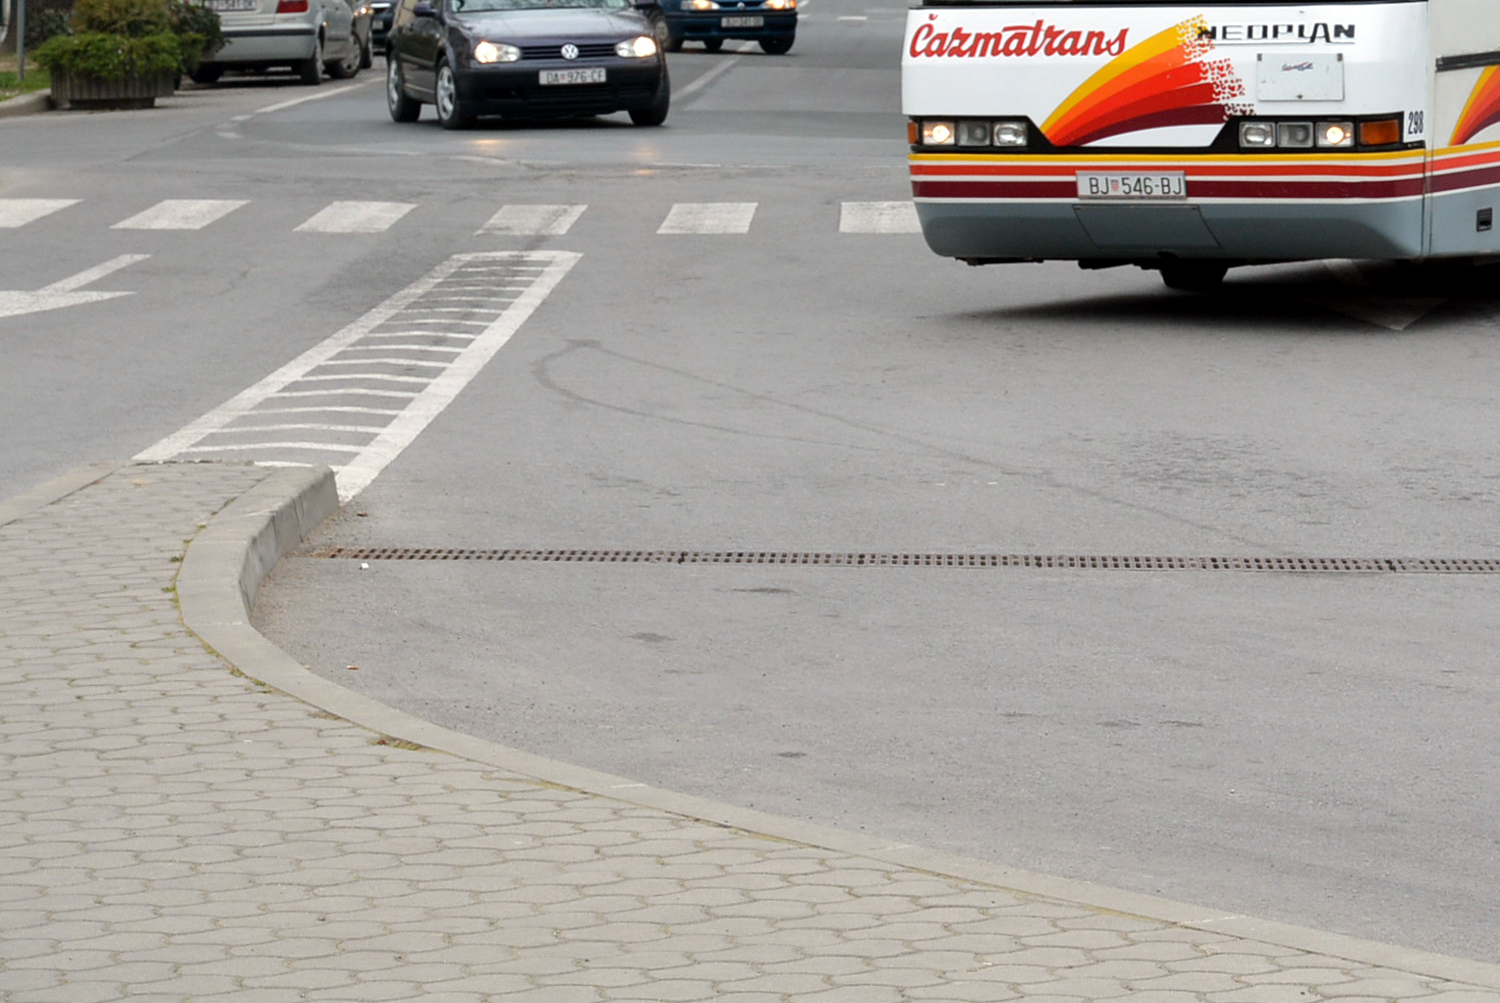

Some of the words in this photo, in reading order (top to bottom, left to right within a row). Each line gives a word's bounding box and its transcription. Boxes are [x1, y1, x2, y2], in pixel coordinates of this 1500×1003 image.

[909, 14, 1130, 58] Čazmatrans
[1197, 23, 1356, 44] NEOPLAN
[1408, 110, 1424, 135] 298
[1089, 177, 1110, 195] BJ
[1121, 177, 1183, 195] 546-BJ
